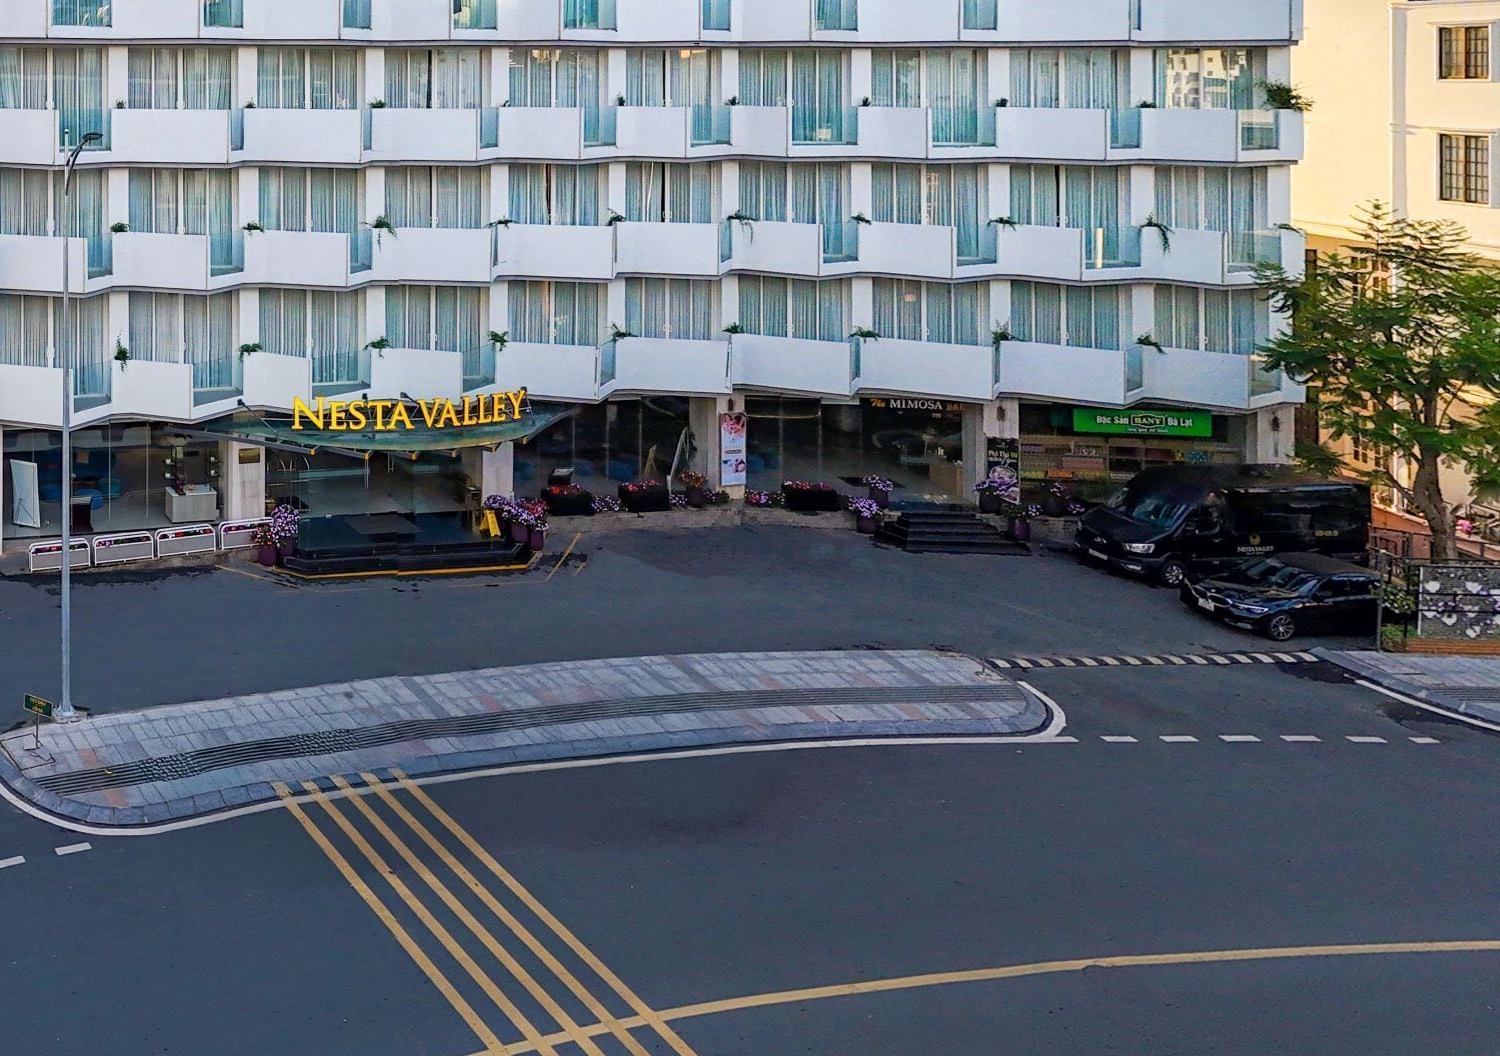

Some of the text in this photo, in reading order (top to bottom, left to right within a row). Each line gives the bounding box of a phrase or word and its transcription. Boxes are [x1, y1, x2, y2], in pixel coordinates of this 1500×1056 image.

[291, 390, 528, 431] NESTA VALLEY
[889, 399, 943, 410] MIMOSA
